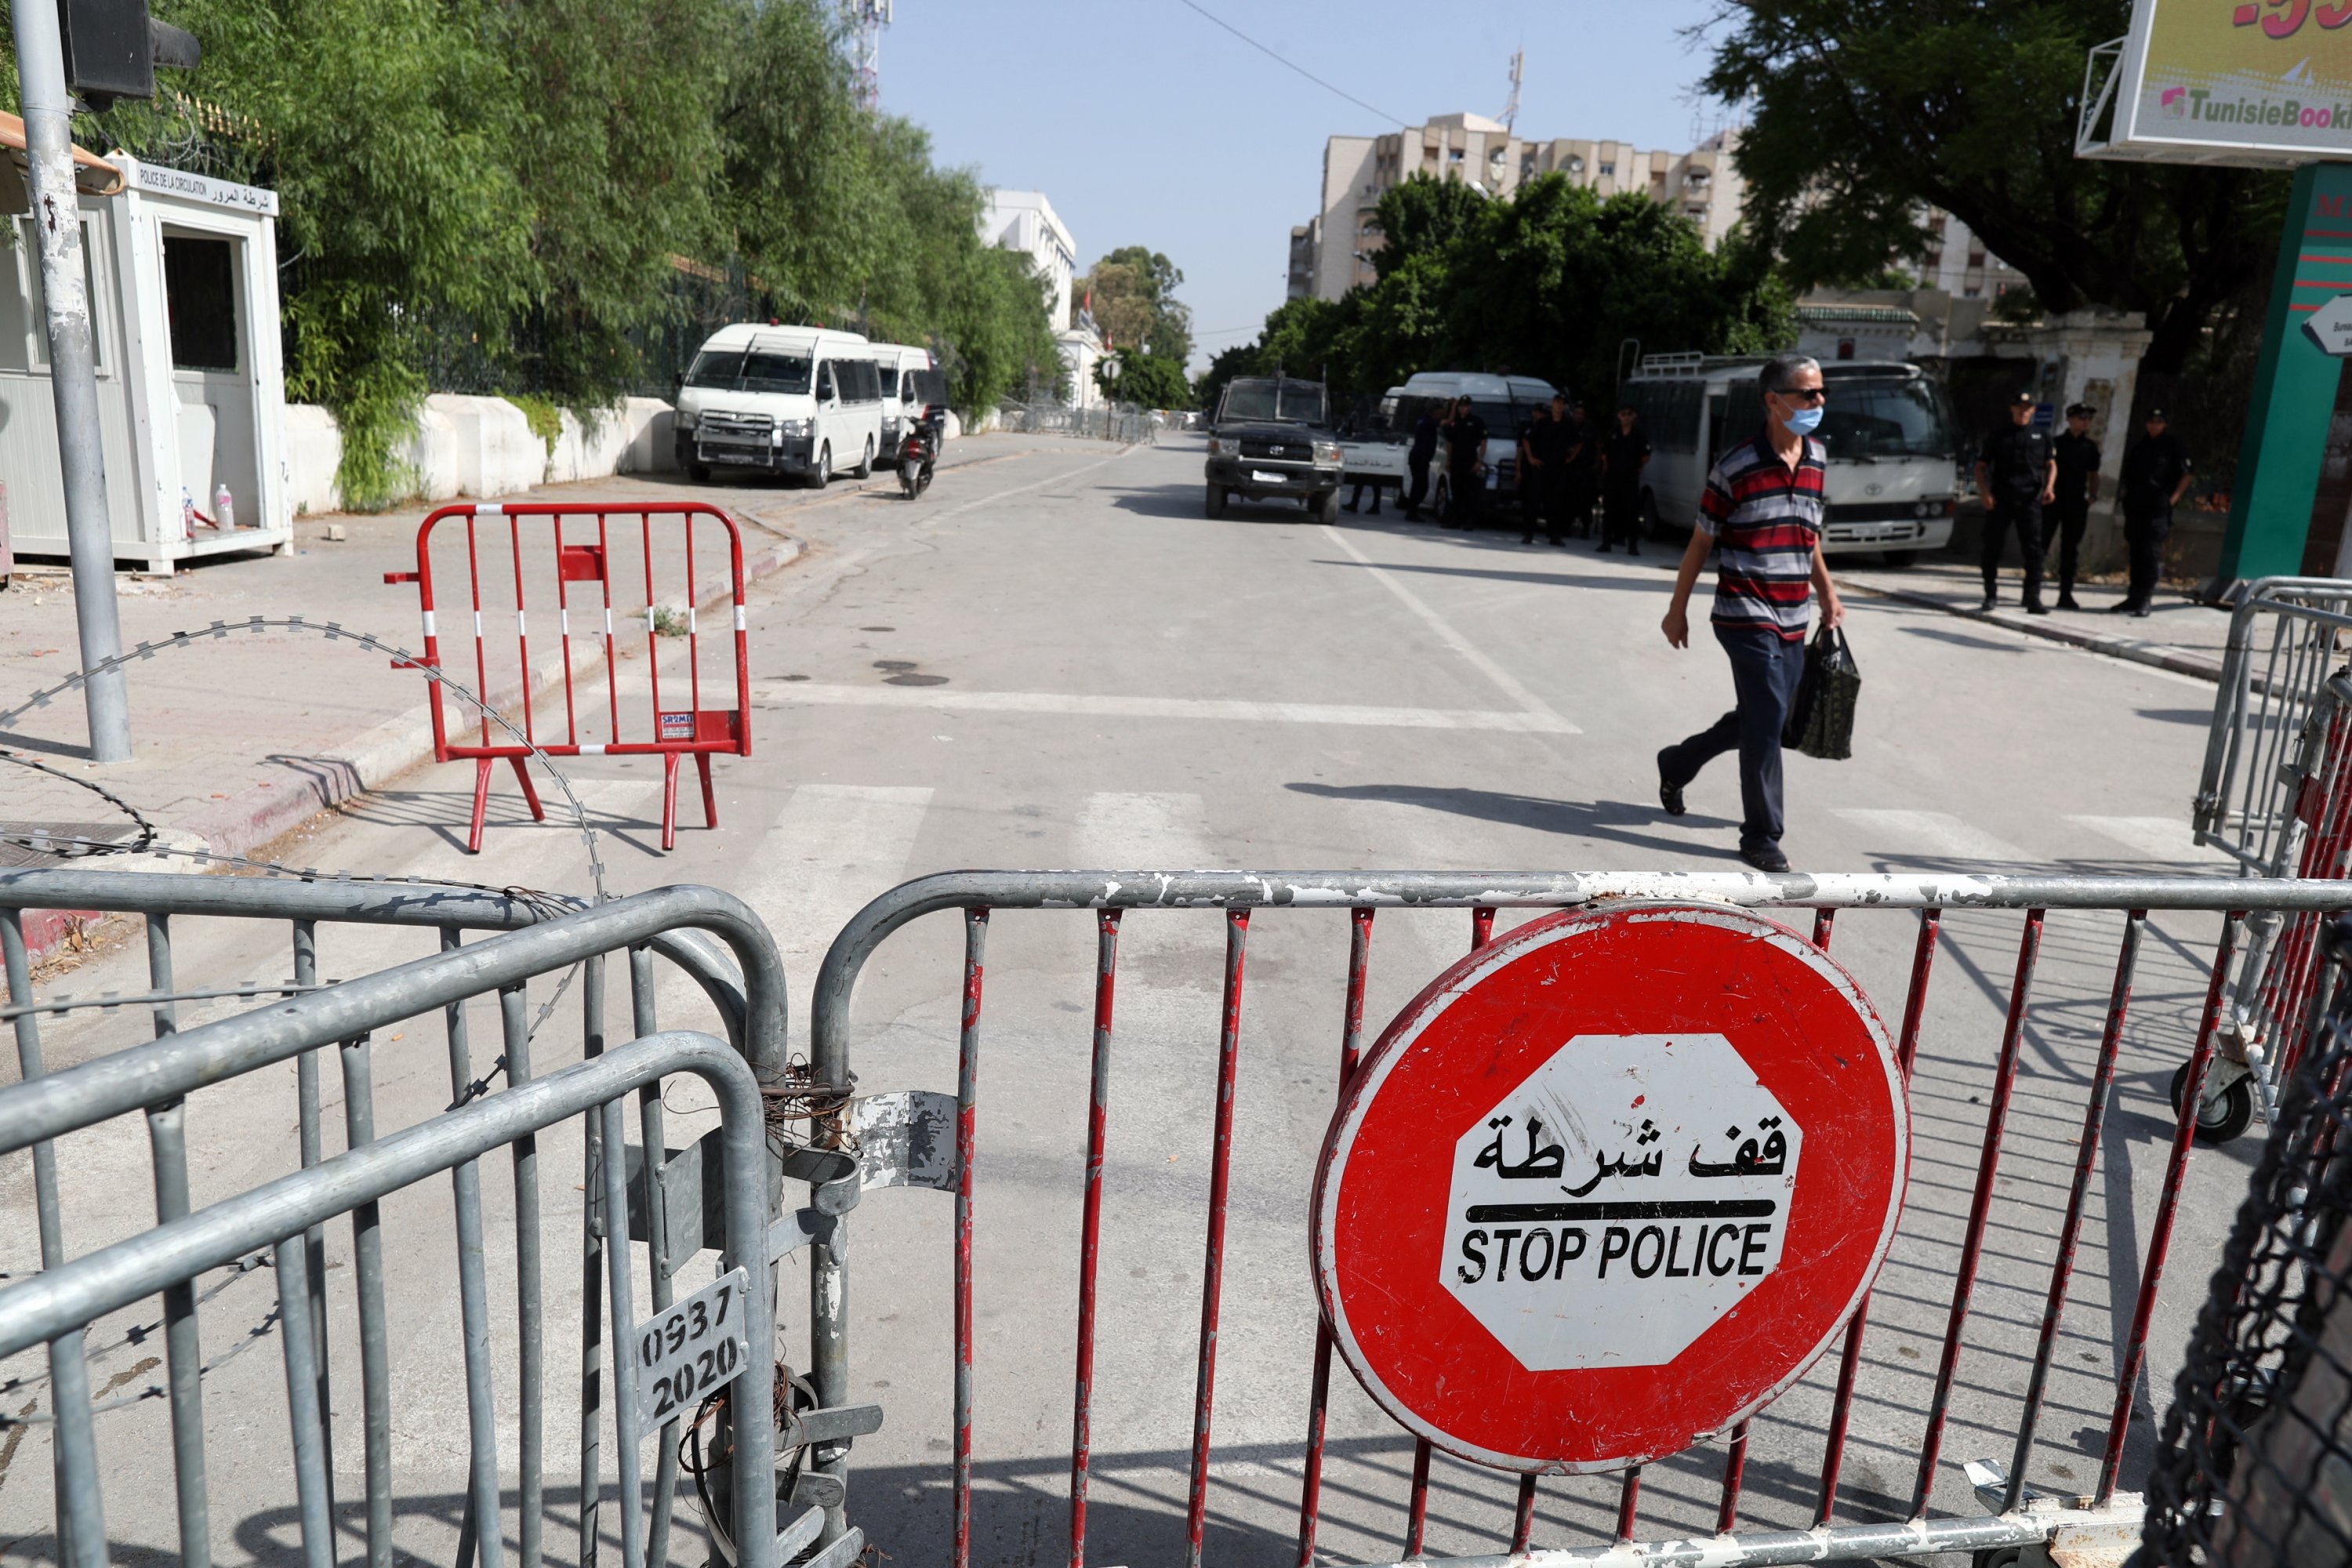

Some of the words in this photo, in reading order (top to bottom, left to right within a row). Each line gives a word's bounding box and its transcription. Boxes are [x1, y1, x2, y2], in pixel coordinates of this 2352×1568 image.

[140, 169, 159, 187] POLICE
[160, 173, 168, 188] DE
[168, 176, 175, 190] LA
[175, 177, 207, 196] CIRCULATION
[212, 189, 239, 204] المرور
[243, 188, 269, 210] شرطة
[1472, 1114, 1664, 1198] شرطة
[1688, 1115, 1788, 1178] قف
[1457, 1226, 1588, 1285] STOP
[1597, 1223, 1772, 1279] POLICE
[641, 1284, 732, 1367] 0937
[652, 1336, 738, 1419] 2020
